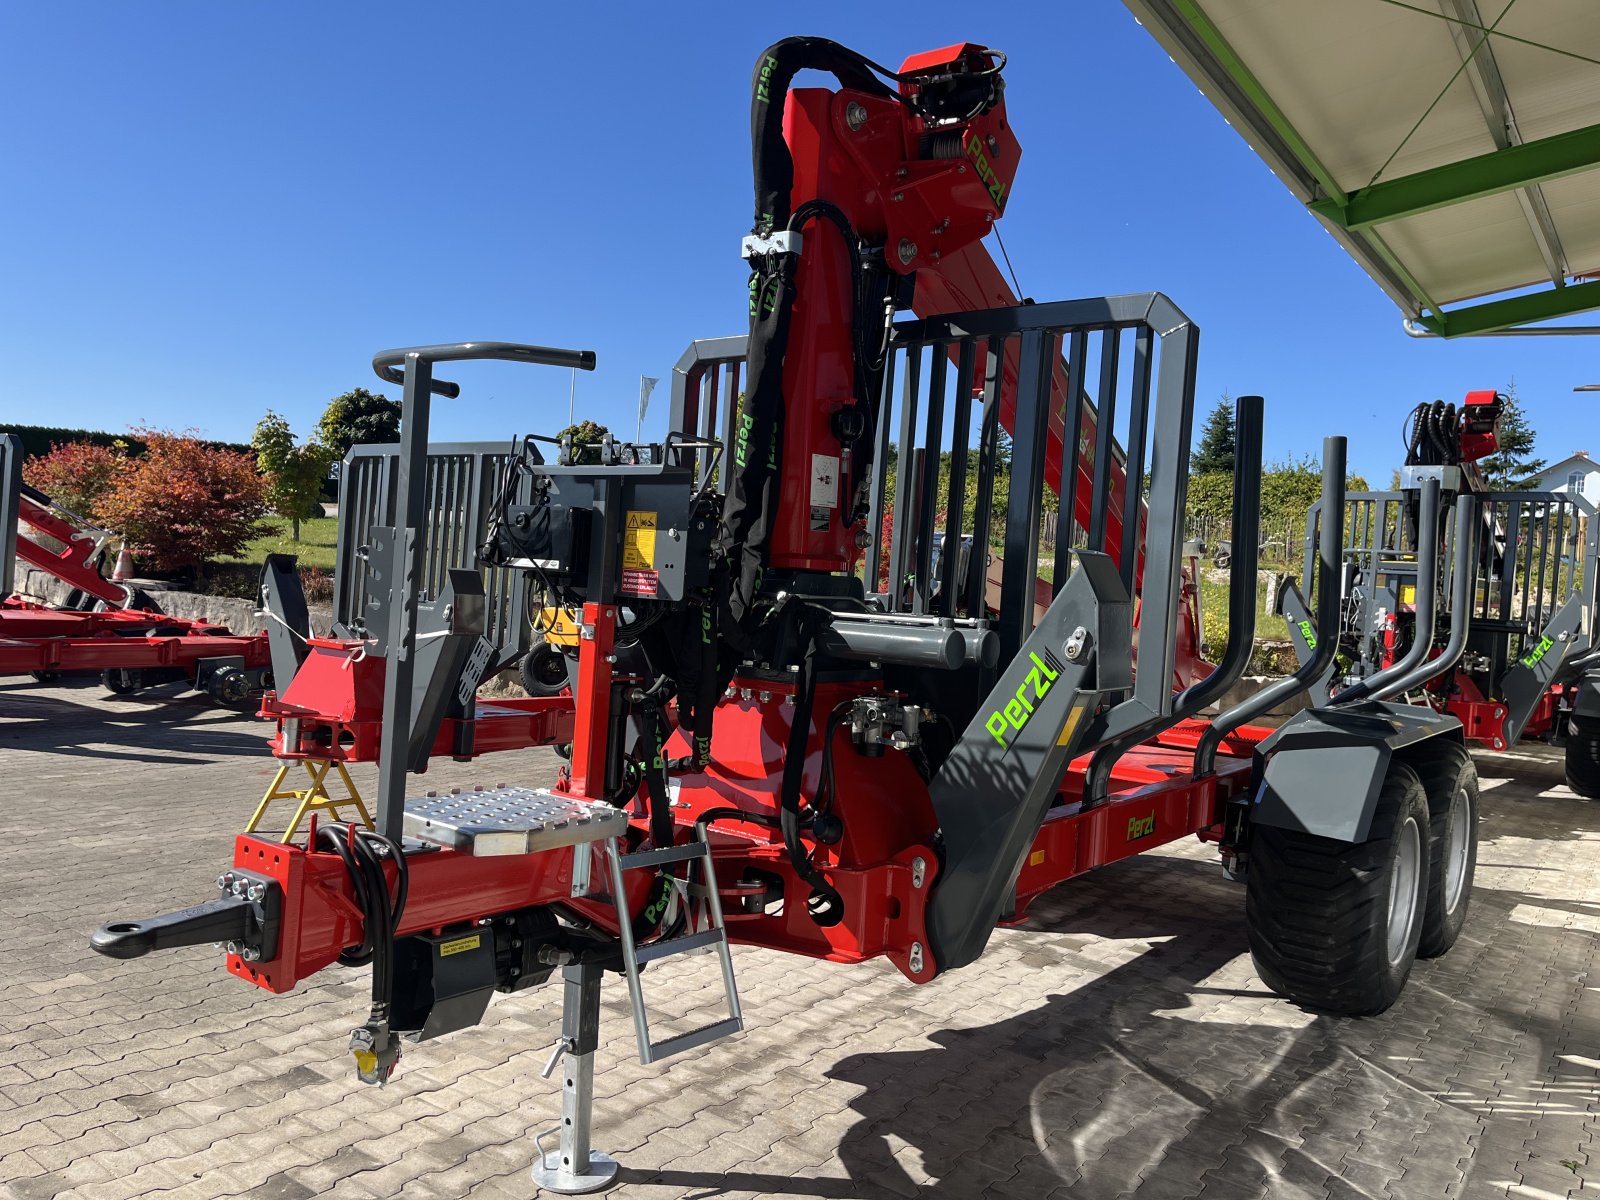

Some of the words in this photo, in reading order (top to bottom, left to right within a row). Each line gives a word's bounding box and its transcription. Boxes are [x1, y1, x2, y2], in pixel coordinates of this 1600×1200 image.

[757, 55, 778, 104] Perzl
[967, 135, 1006, 207] Perzl
[736, 413, 753, 468] Perzl
[1298, 621, 1316, 650] Perzl
[1524, 635, 1553, 669] Perzl
[985, 651, 1058, 750] Perzl
[1127, 809, 1155, 841] Perzl
[644, 873, 675, 925] Perzl
